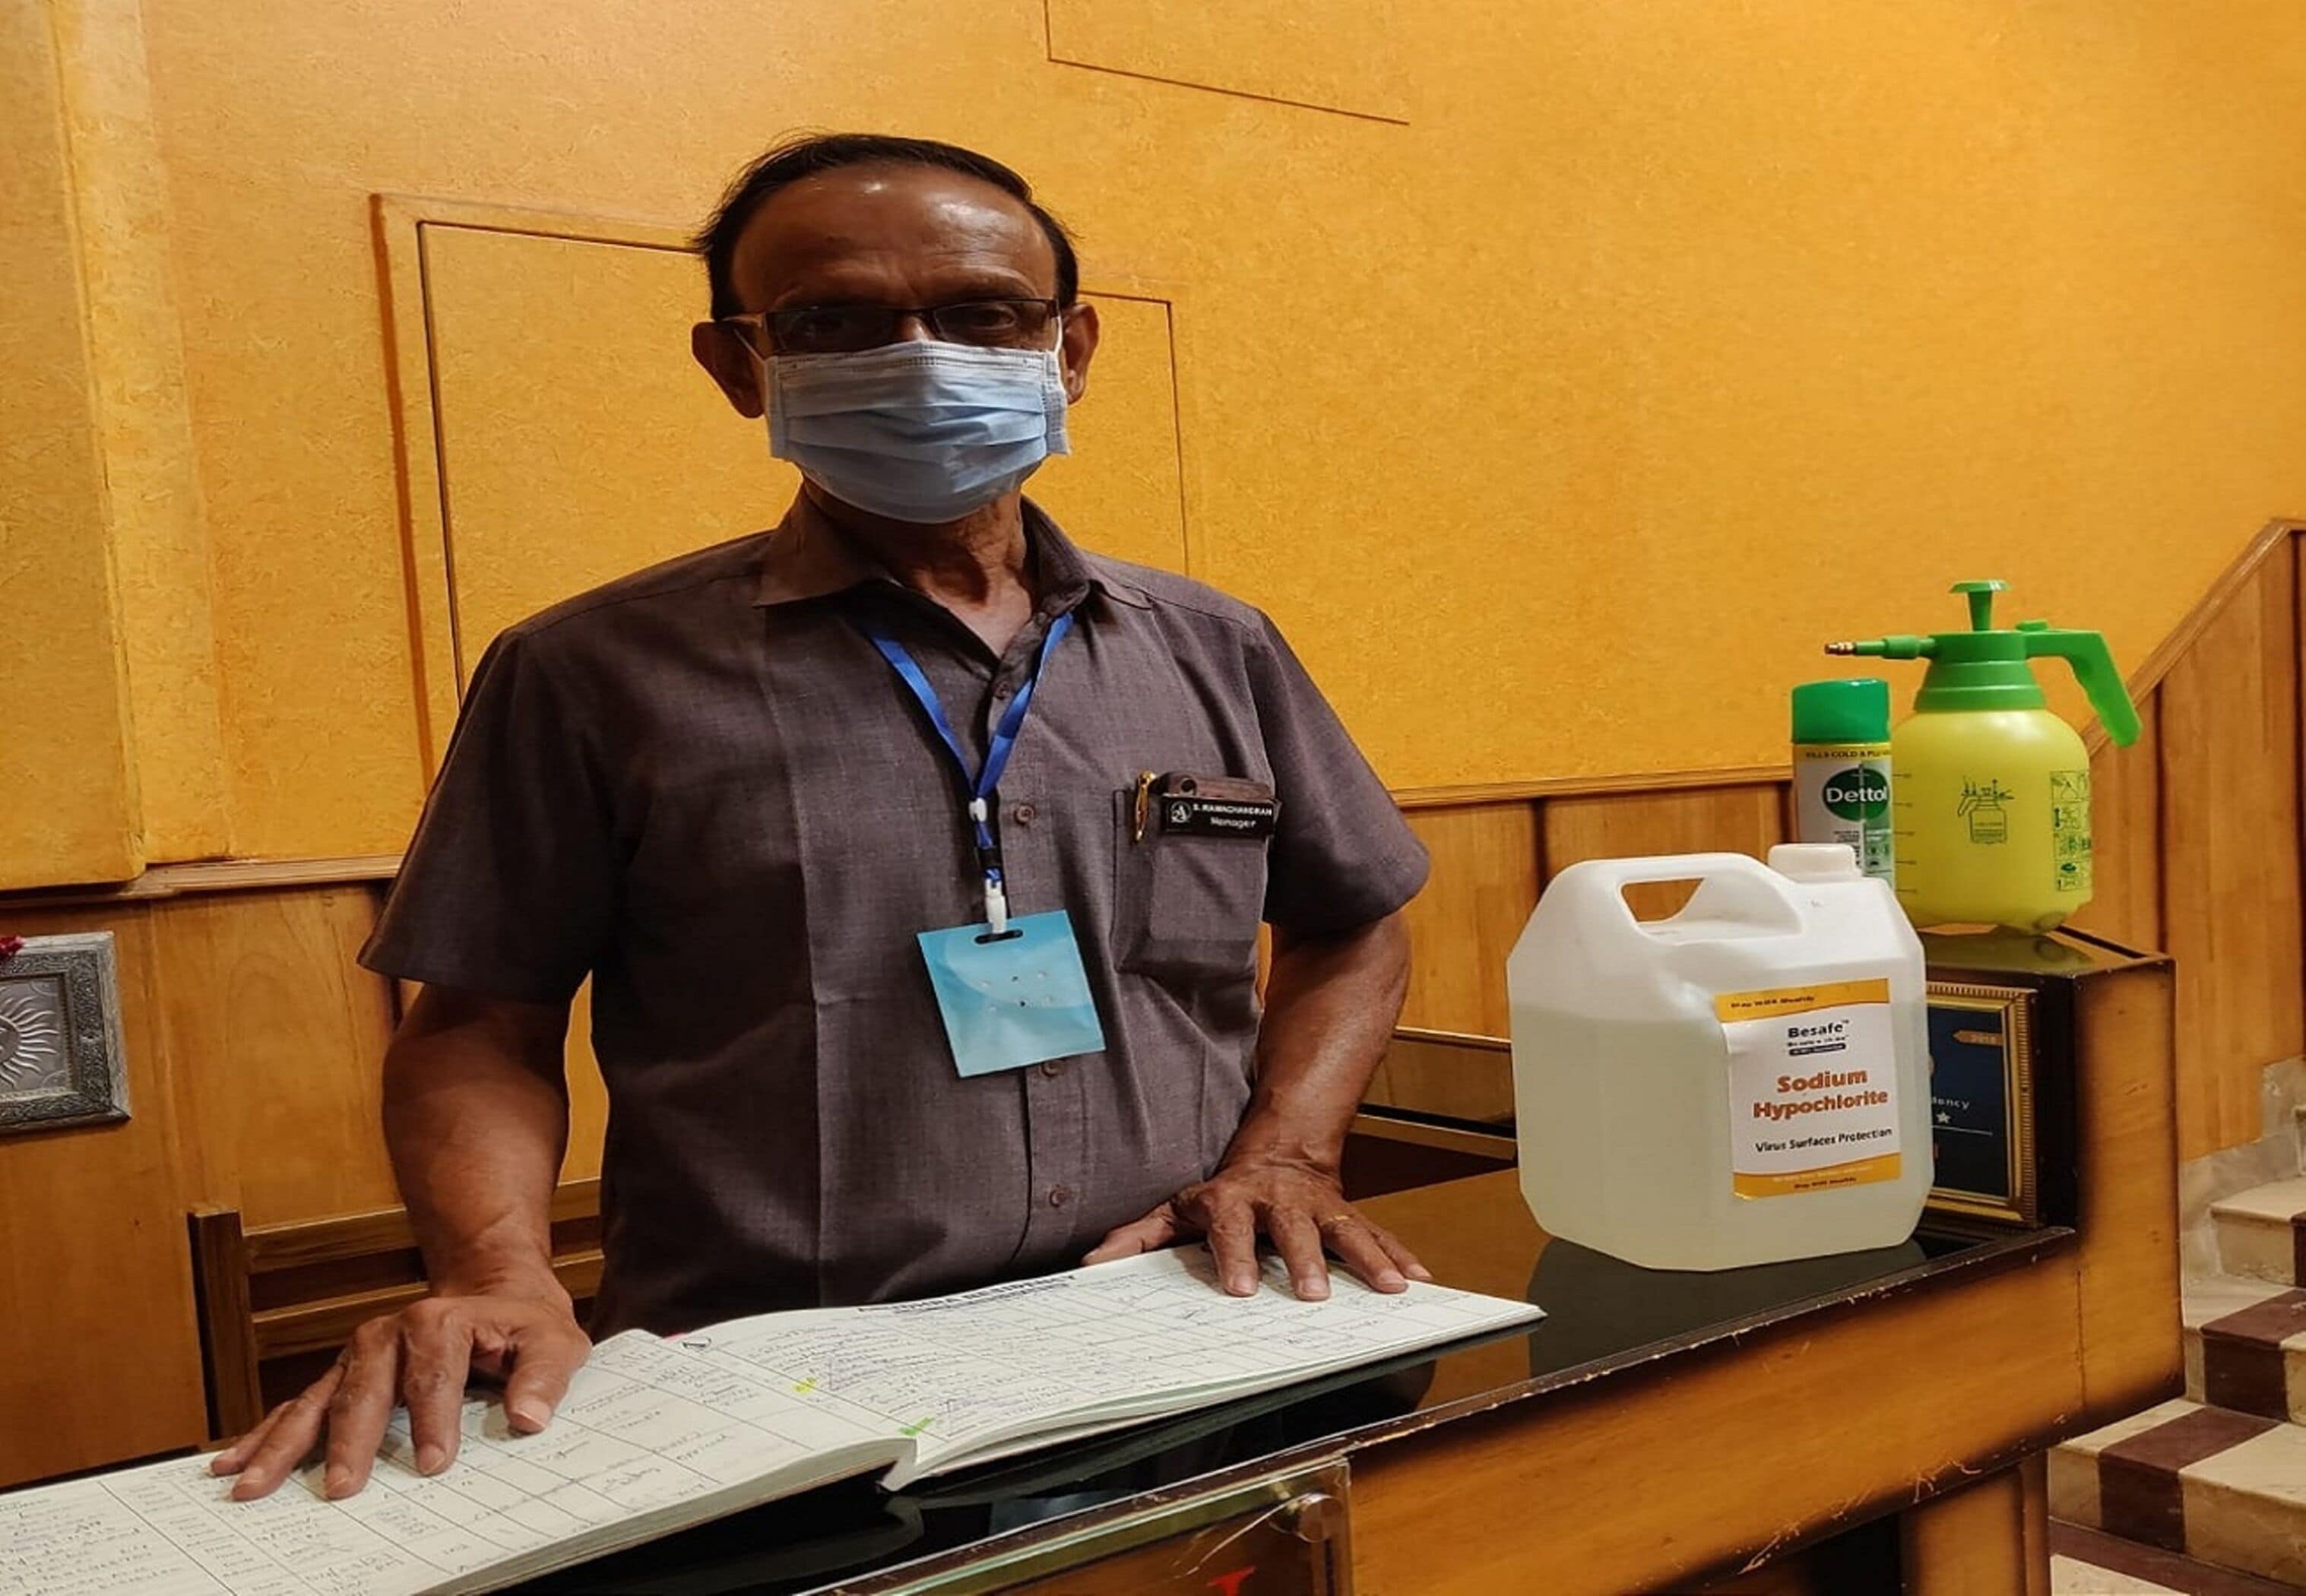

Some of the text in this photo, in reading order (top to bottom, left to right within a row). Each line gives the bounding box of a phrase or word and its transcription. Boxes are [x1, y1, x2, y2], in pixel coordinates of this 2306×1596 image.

[1826, 786, 1887, 803] Dettol
[1211, 816, 1256, 829] Manager
[1777, 1070, 1867, 1093] Sodium
[1753, 1091, 1888, 1121] Hypochlorite
[1755, 1128, 1893, 1152] Virus Surfaces Protection
